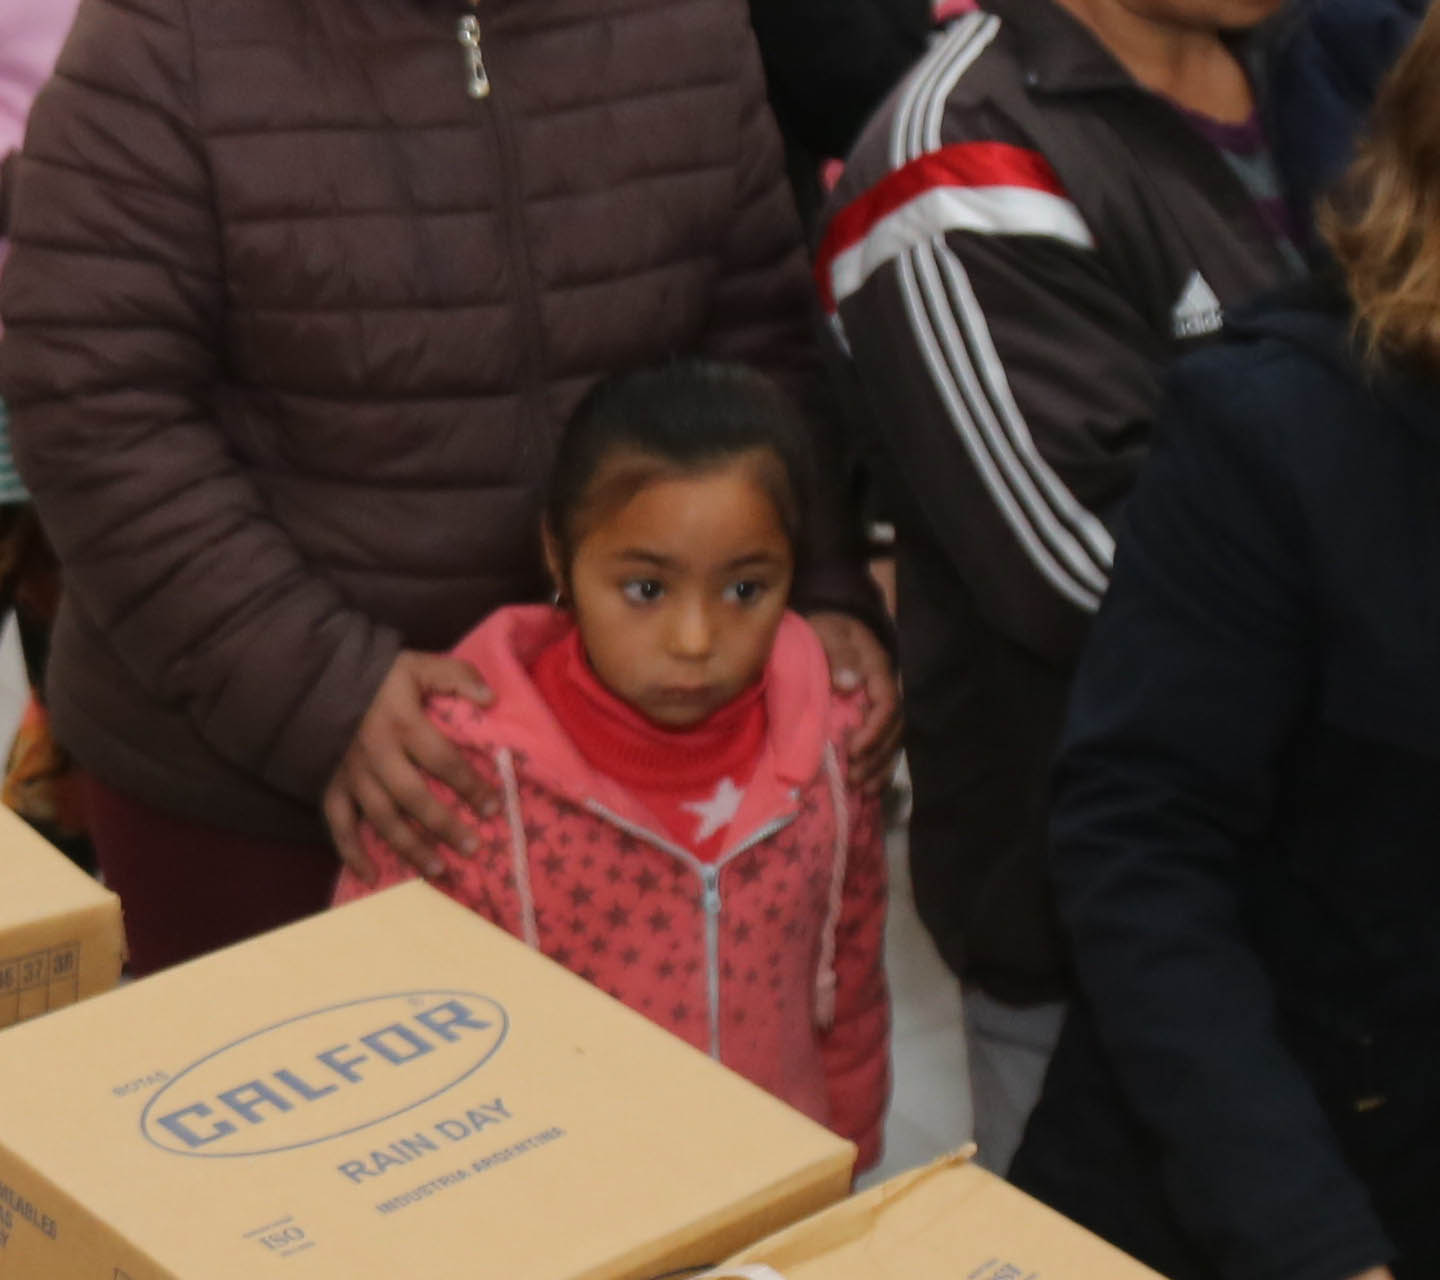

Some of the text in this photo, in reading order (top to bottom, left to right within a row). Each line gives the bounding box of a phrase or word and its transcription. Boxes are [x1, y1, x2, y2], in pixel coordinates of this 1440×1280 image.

[156, 1000, 492, 1149] CALFOR
[338, 1097, 513, 1183] RAIN DAY
[376, 1169, 470, 1216] INDUSTRIA
[259, 1225, 305, 1252] ISO
